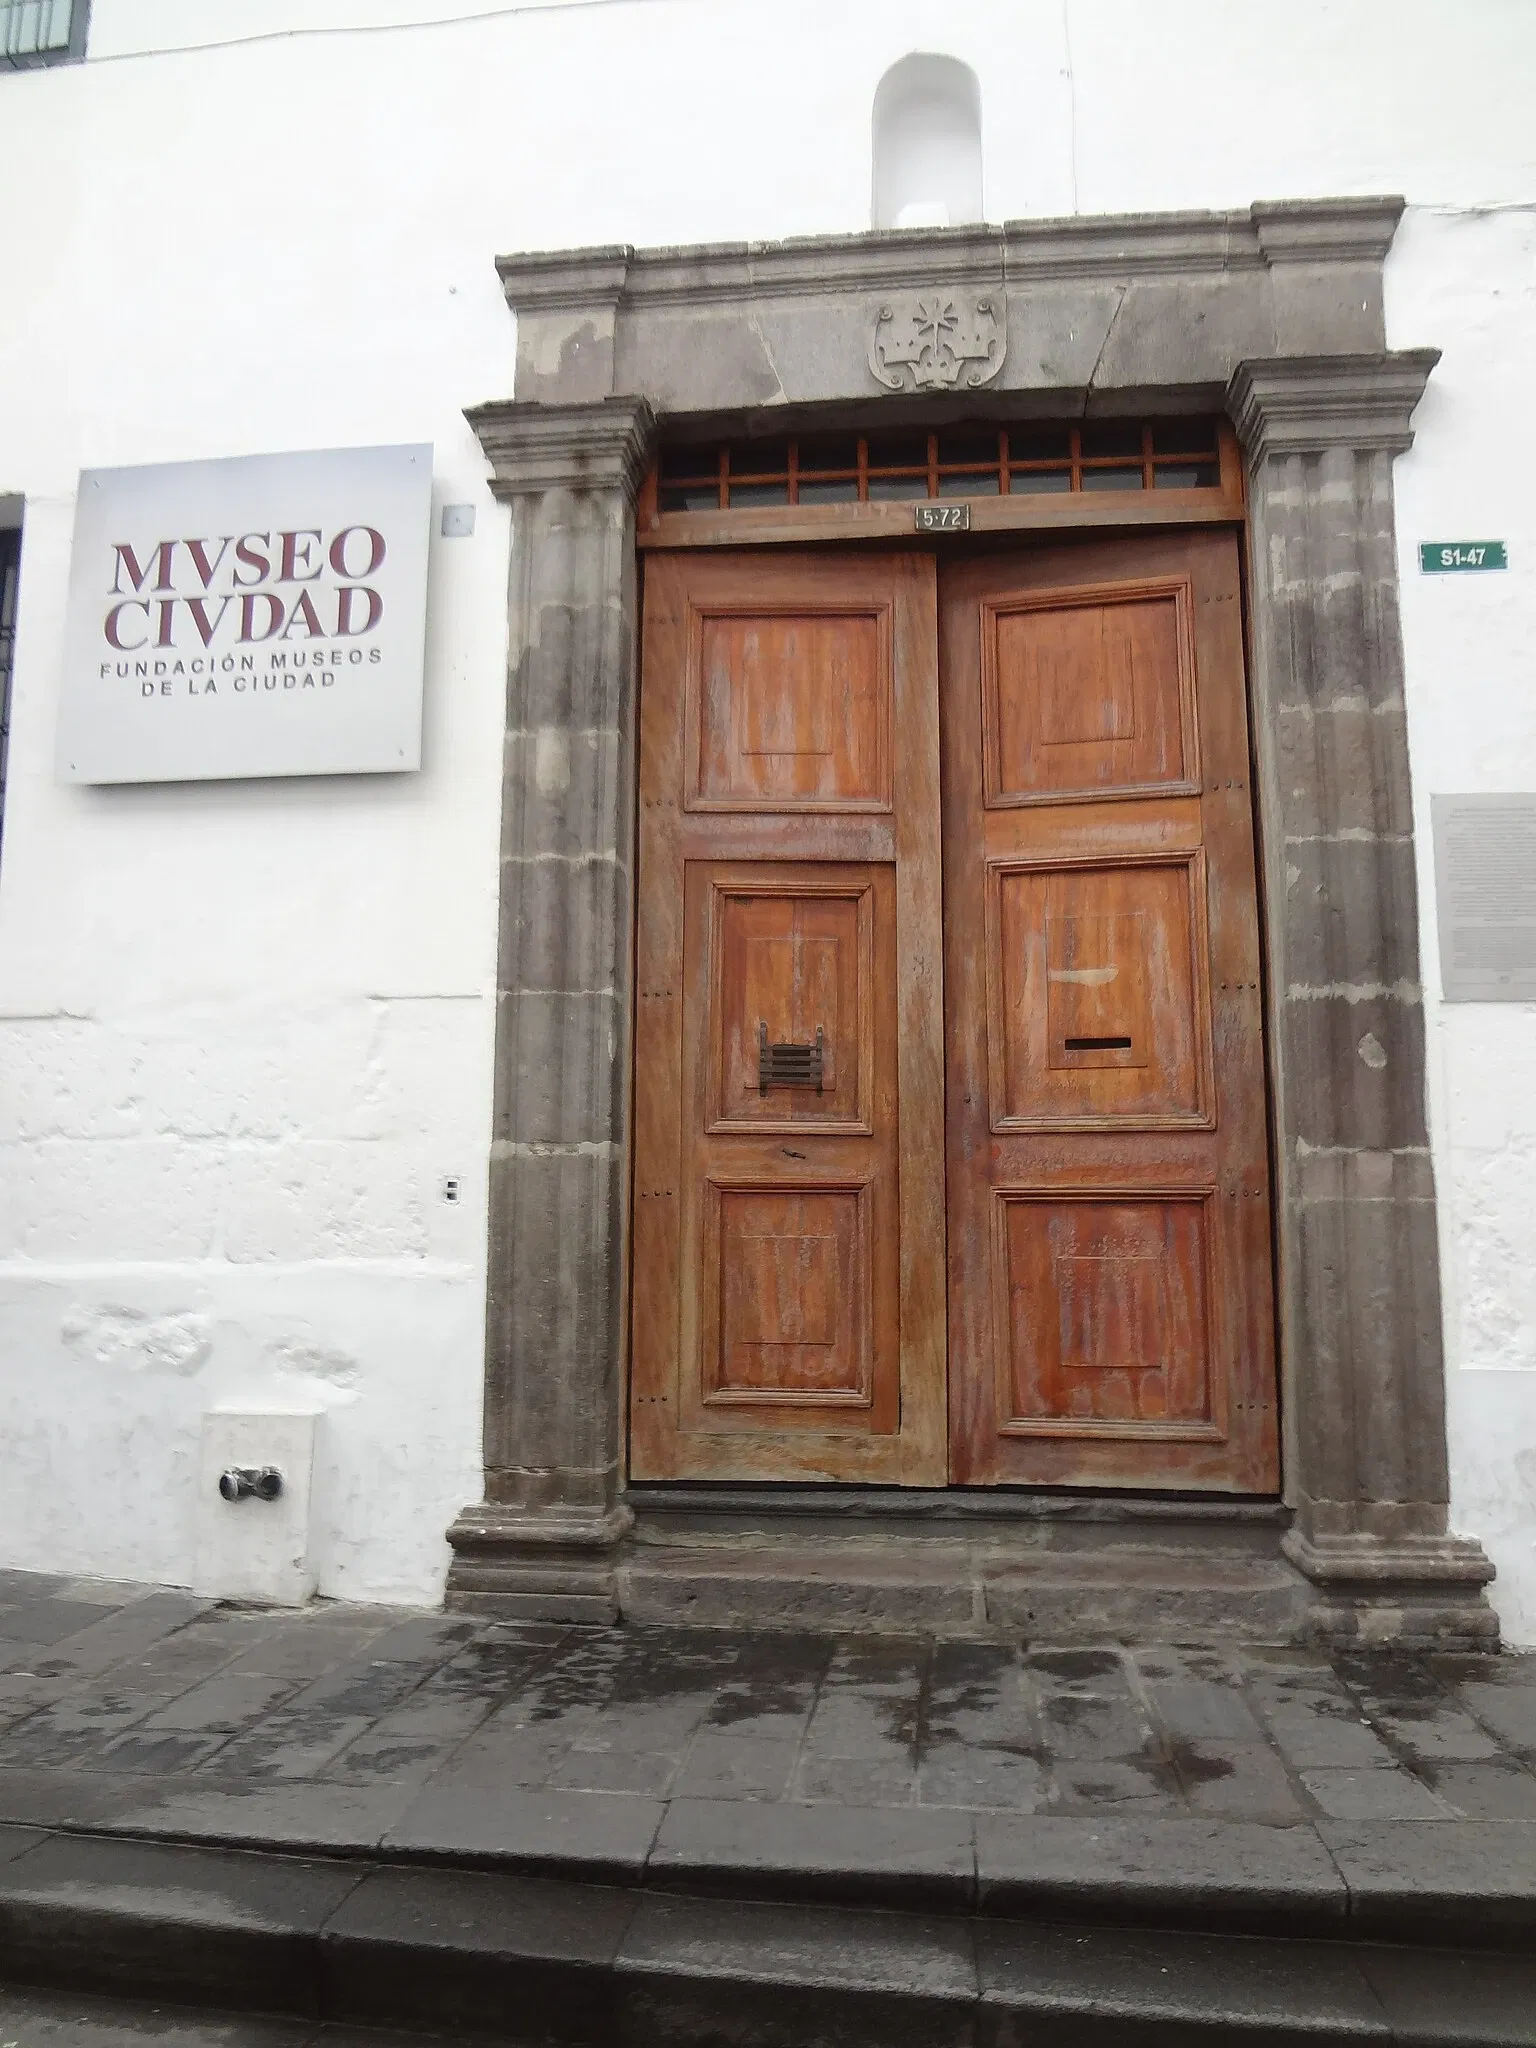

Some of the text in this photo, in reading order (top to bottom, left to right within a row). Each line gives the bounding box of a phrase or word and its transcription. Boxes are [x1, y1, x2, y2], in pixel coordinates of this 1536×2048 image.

[106, 525, 388, 596] MVSEO
[1440, 547, 1486, 566] S1-47
[102, 585, 384, 652] CIVDAD
[99, 648, 384, 678] FUNDACIÓN MUSEOS
[141, 672, 336, 697] DE LA CIUDAD
